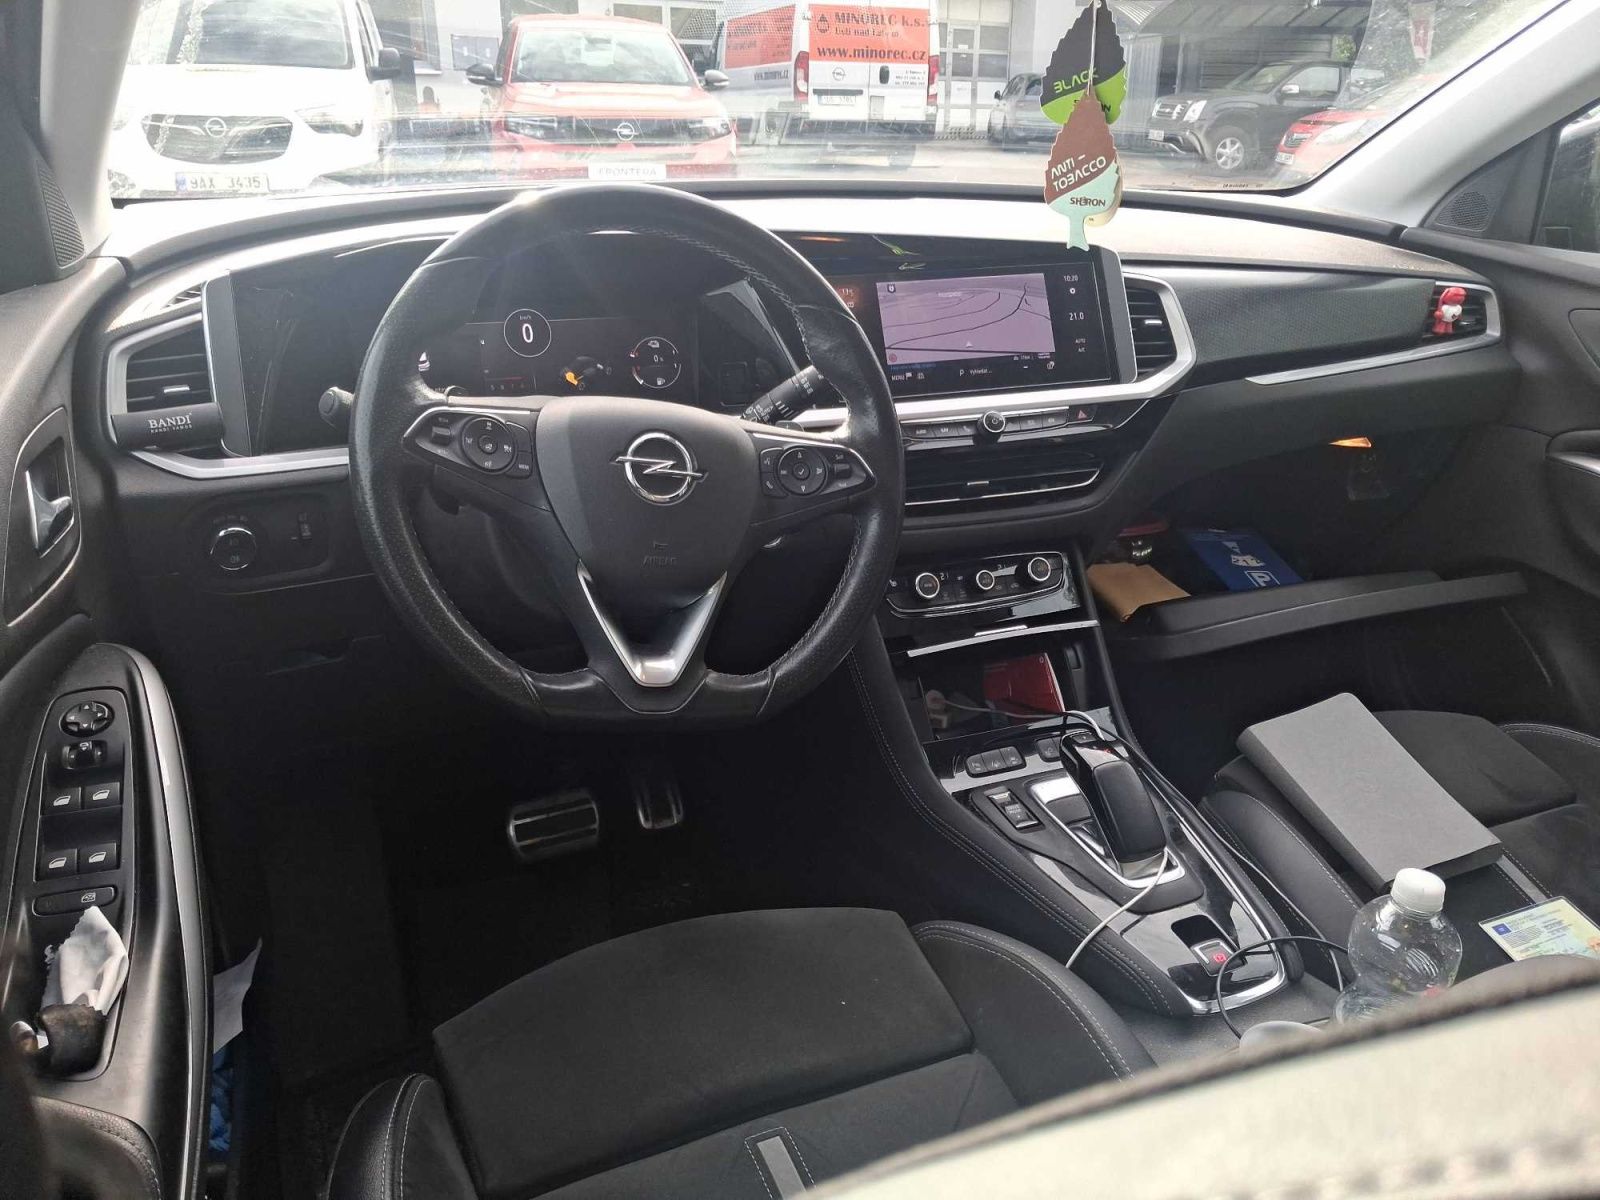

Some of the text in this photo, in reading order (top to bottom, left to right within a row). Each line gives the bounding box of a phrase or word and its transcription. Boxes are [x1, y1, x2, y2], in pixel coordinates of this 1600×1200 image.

[817, 46, 926, 60] www.minorec.cz
[1053, 156, 1106, 192] TOBACCO
[1070, 196, 1106, 207] SHERON
[1069, 312, 1085, 320] 21.0
[522, 323, 533, 343] 0
[148, 415, 191, 429] BANDI
